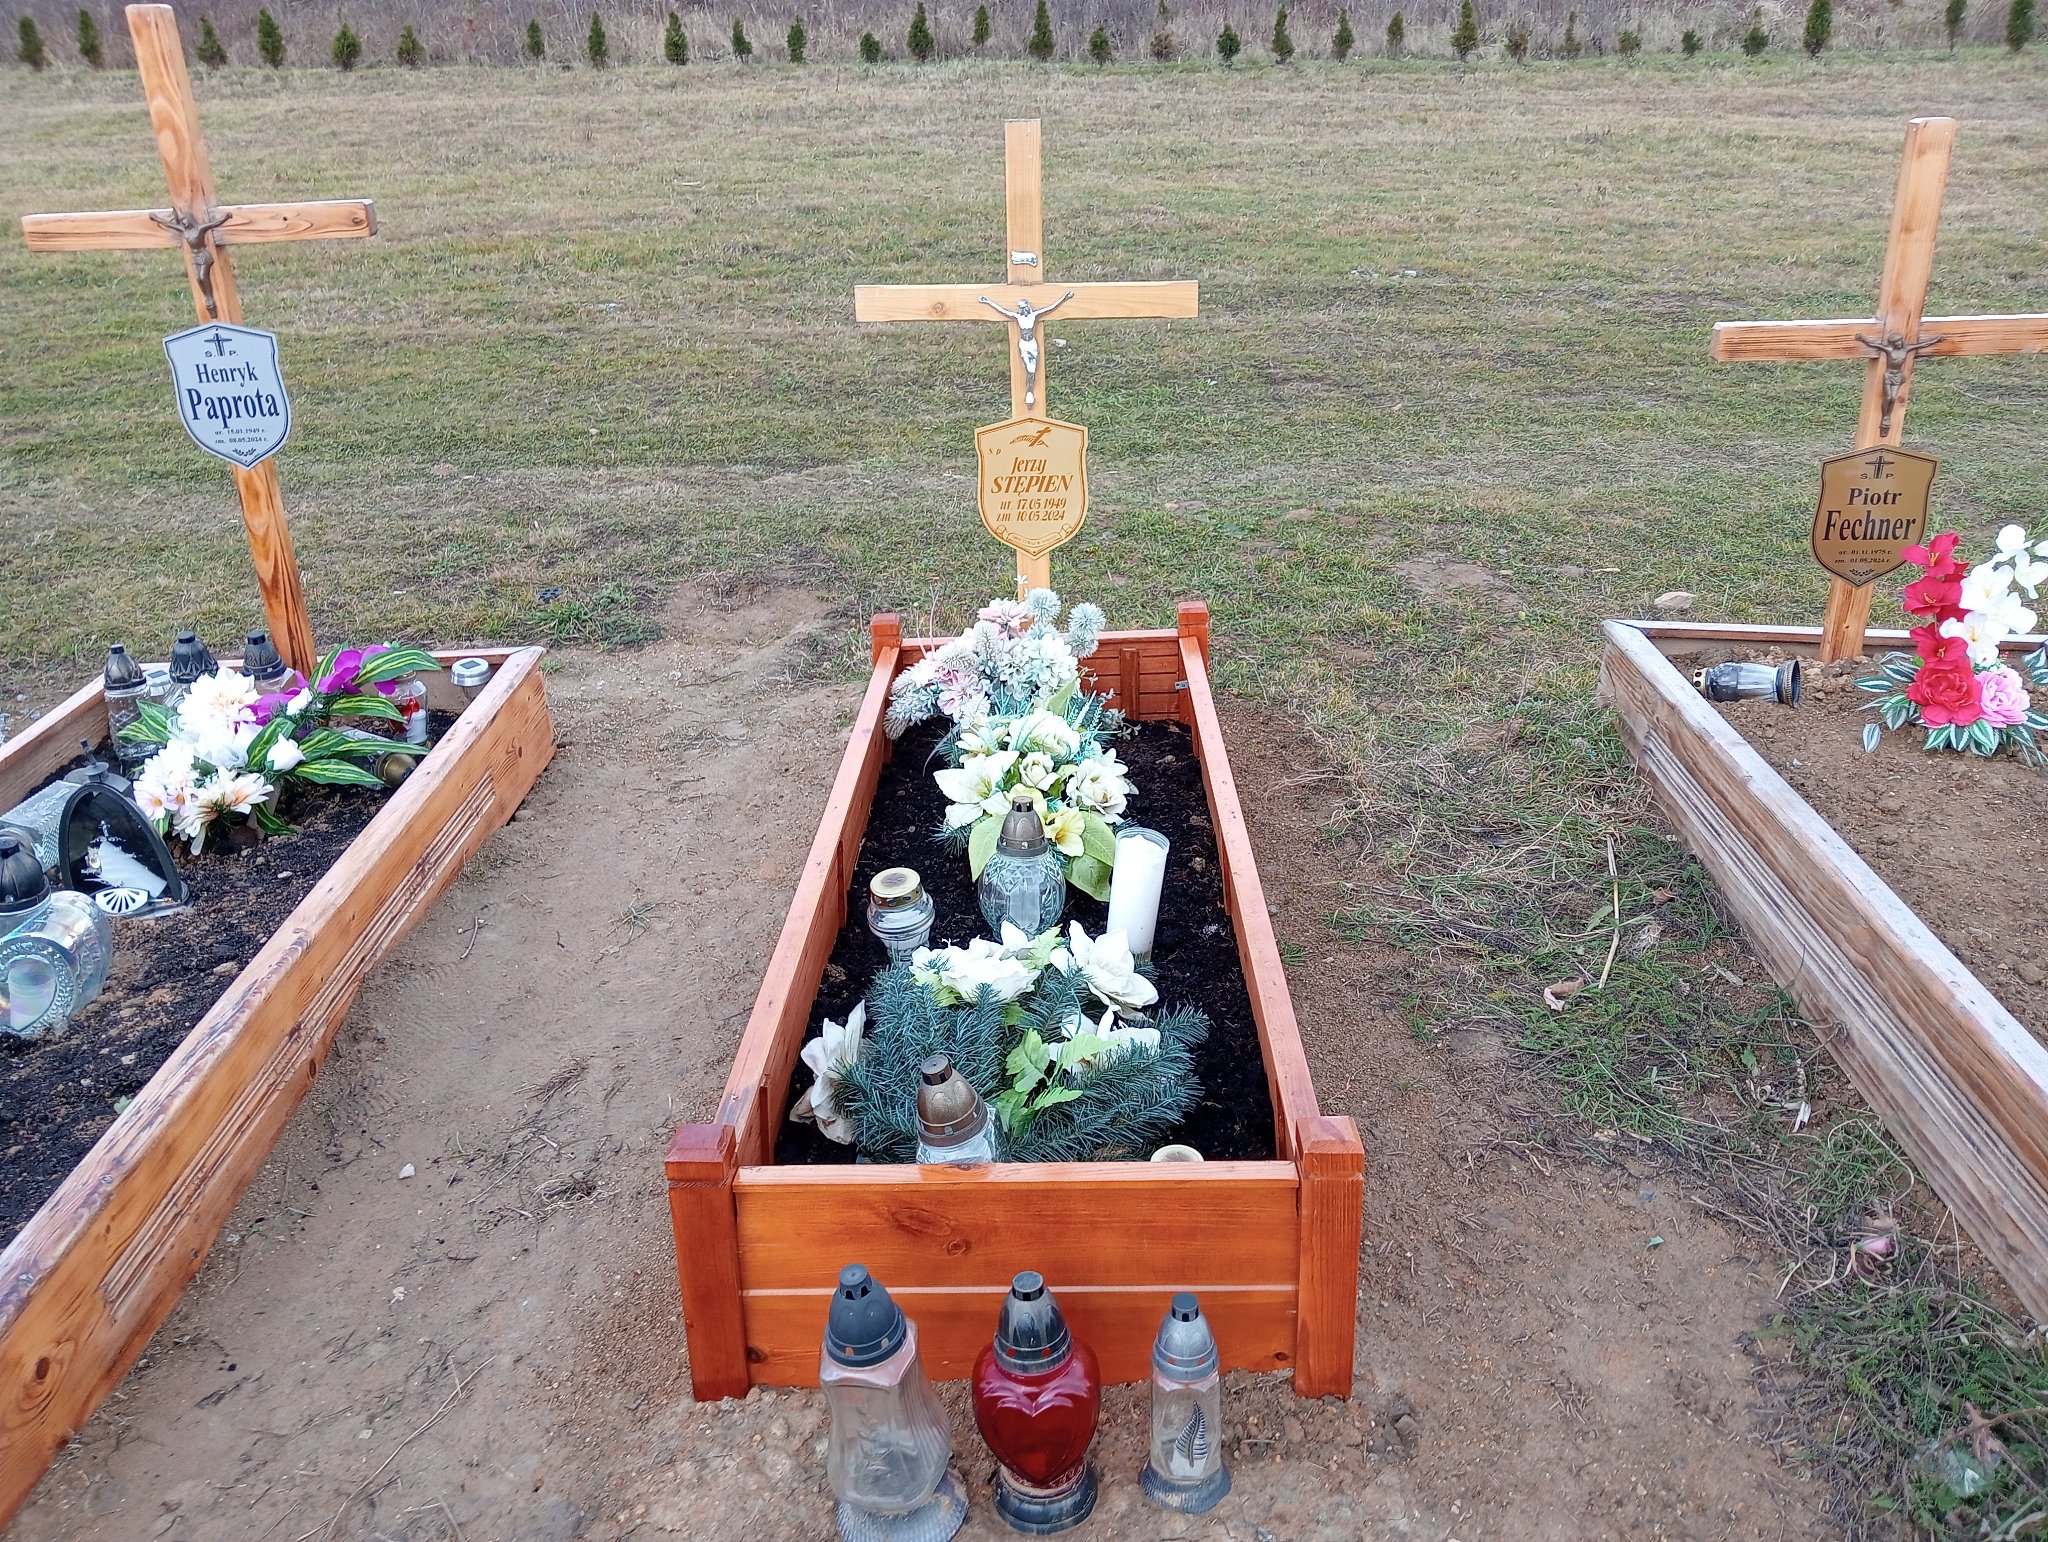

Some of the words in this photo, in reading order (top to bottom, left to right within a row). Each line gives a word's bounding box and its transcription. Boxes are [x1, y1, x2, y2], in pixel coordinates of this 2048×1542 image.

[194, 361, 259, 387] Henryk
[186, 387, 280, 429] Paprota
[1010, 456, 1047, 475] Jerzy
[1847, 487, 1902, 506] Piotr
[1822, 510, 1917, 541] Fechner
